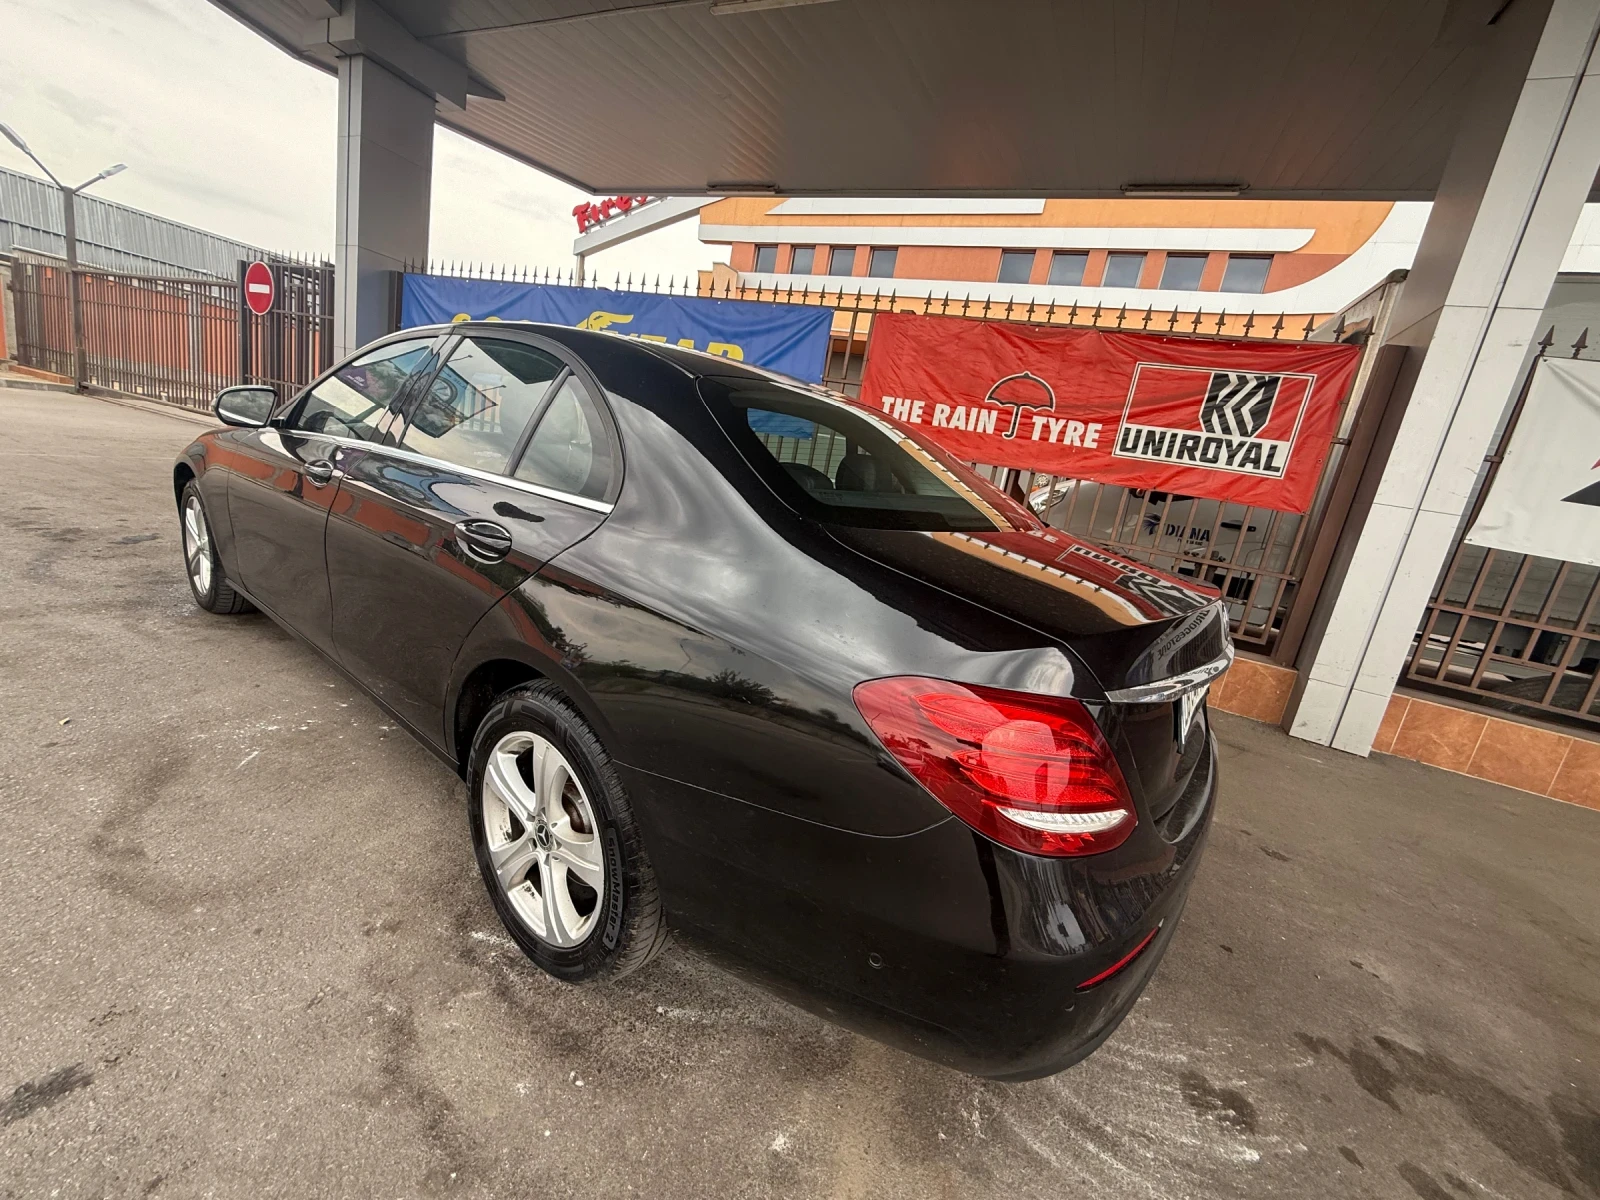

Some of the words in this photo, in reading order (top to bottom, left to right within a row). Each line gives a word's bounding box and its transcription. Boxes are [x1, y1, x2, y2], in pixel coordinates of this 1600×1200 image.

[881, 396, 925, 423] THE
[932, 403, 998, 434] RAIN
[1031, 416, 1102, 449] TYRE
[1119, 427, 1281, 473] UNIROYAL
[606, 932, 615, 944] 2
